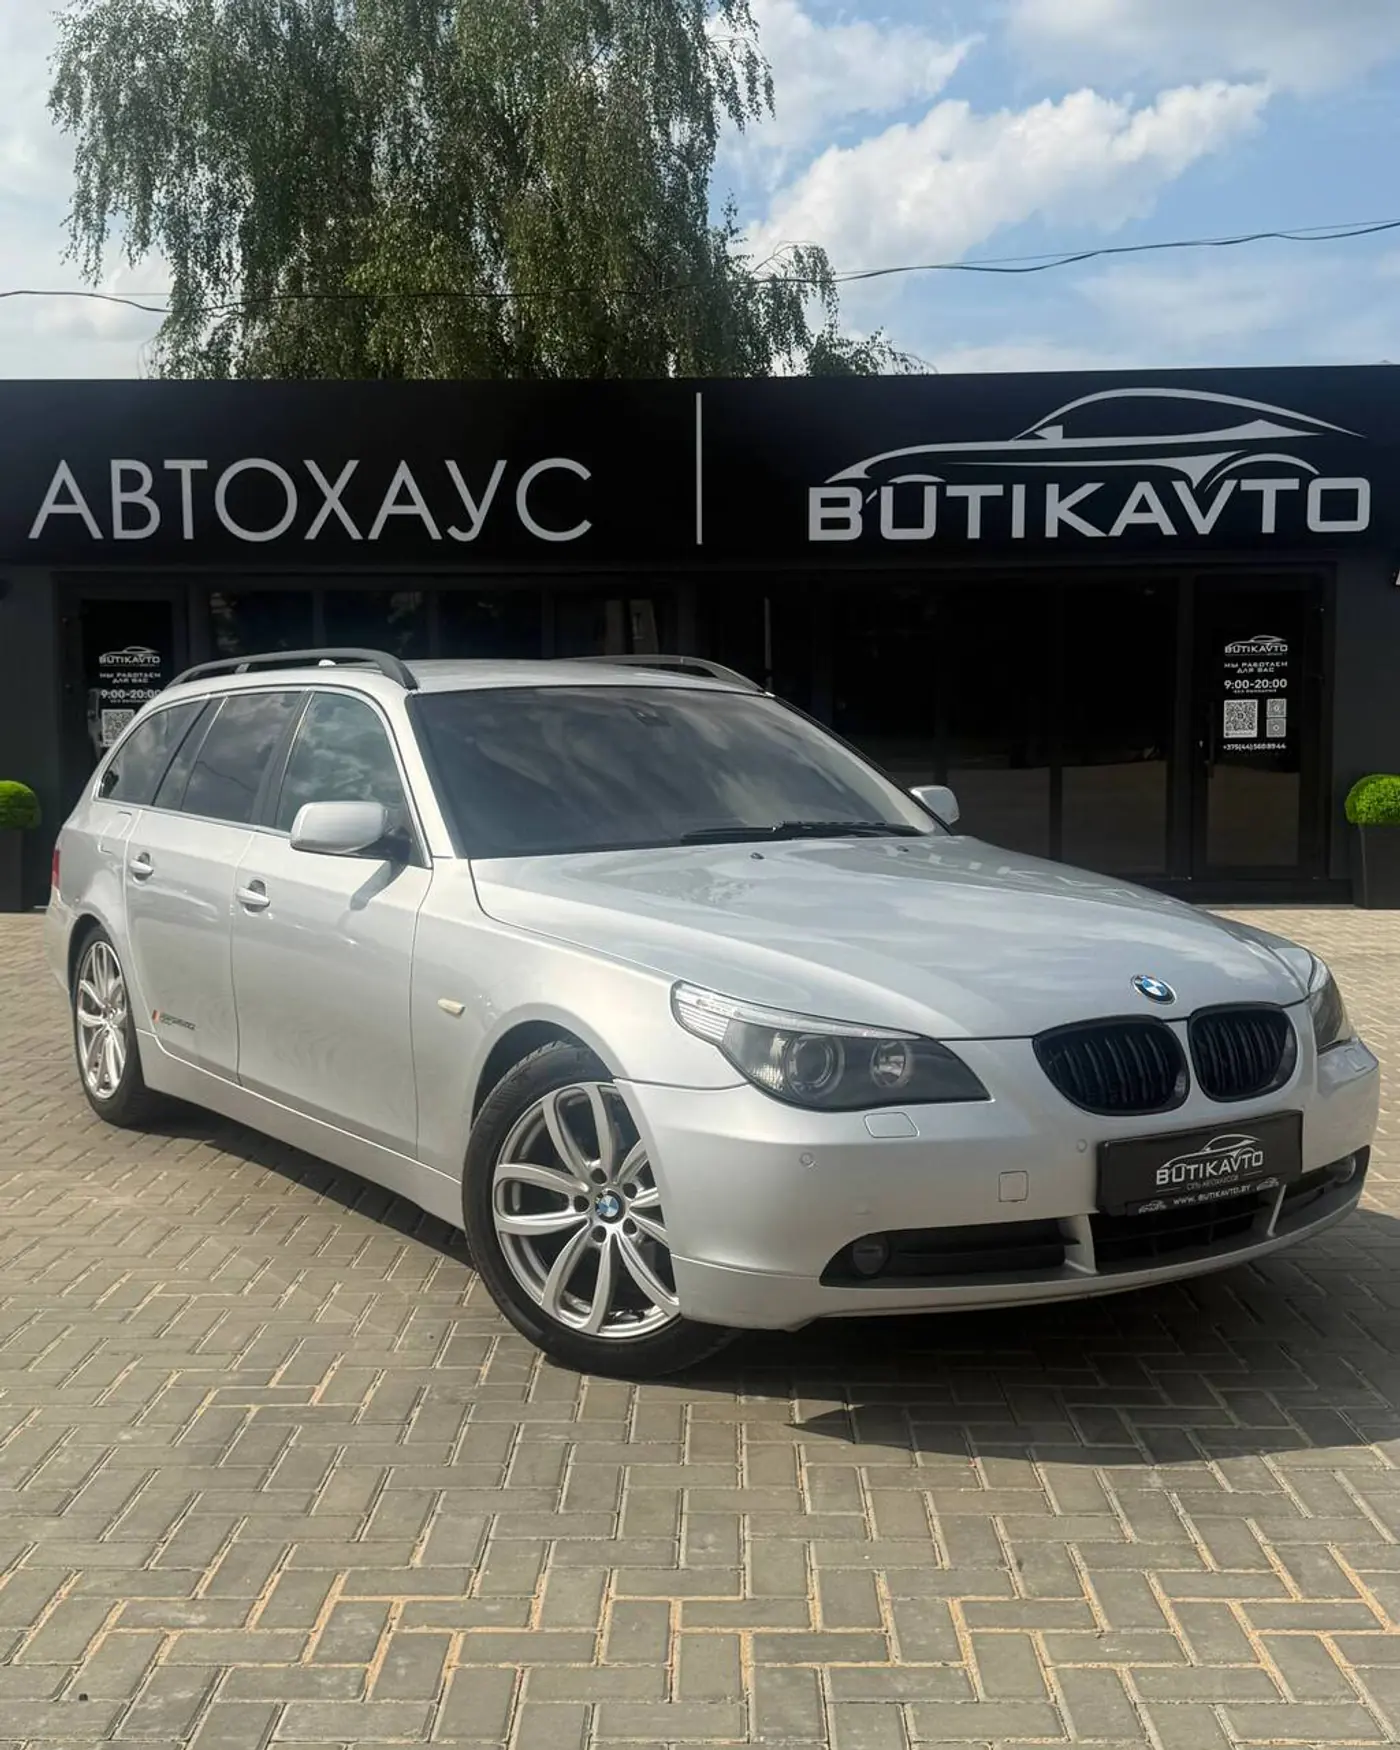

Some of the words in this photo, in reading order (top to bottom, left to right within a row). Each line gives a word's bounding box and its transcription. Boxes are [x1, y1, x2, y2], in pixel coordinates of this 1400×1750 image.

[28, 458, 592, 542] АВТОХАУС
[808, 476, 1371, 541] BUTIKAVTO
[1224, 645, 1288, 654] BUTIKAVTO
[1223, 679, 1288, 690] 9:00-20:00
[1156, 1150, 1263, 1185] BUTIKAVTO
